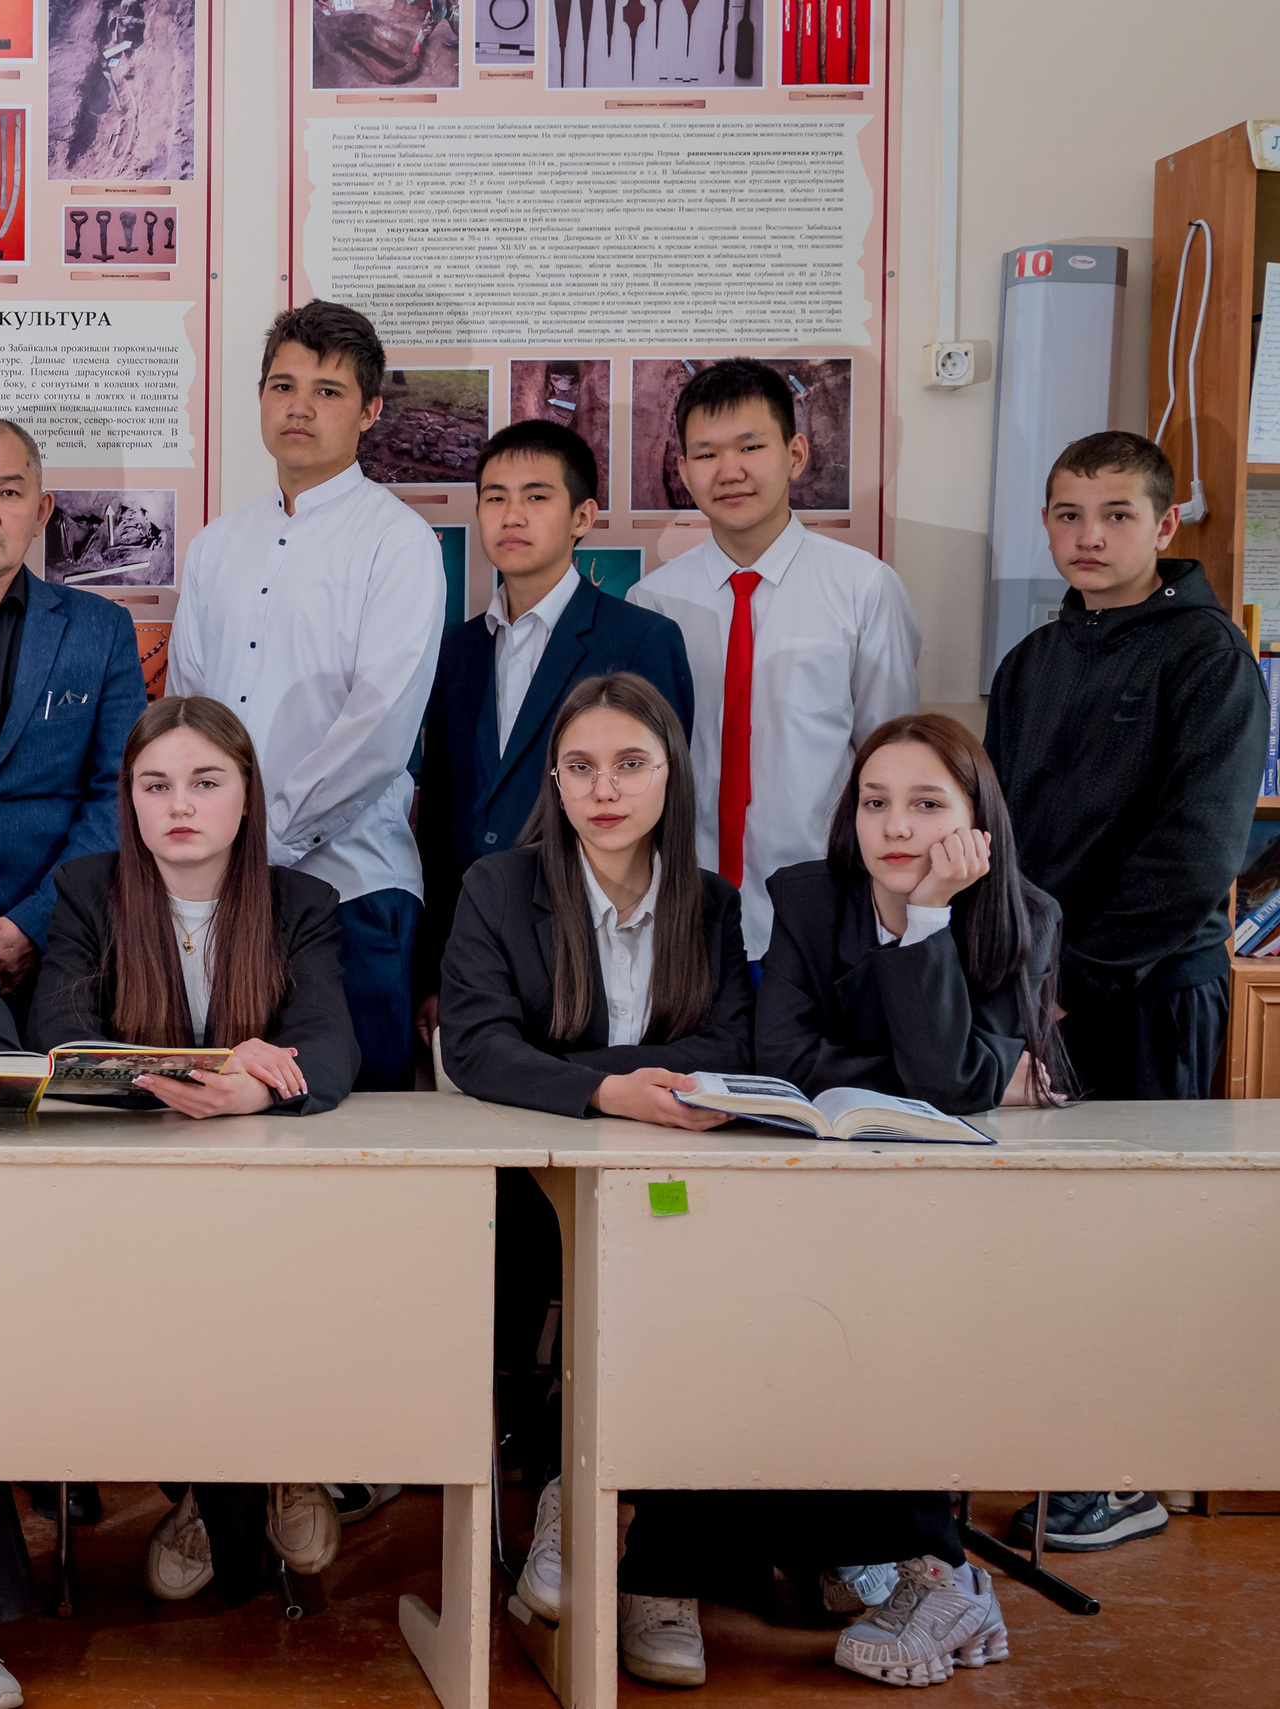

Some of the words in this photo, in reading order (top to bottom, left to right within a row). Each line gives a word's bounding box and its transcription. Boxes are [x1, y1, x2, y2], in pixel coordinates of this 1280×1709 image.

[1016, 250, 1053, 278] 10
[8, 343, 58, 352] Забайкалья
[61, 346, 110, 354] проживали
[114, 346, 179, 355] тюркоязычные
[30, 355, 65, 364] Данные
[116, 358, 179, 366] существовали
[30, 367, 68, 376] Племена
[75, 367, 130, 378] дарасунской
[136, 370, 179, 378] культуры
[3, 379, 26, 390] боку,
[40, 381, 89, 390] согнутыми
[144, 382, 179, 390] ногами,
[43, 393, 80, 402] согнуты
[140, 394, 179, 402] подняты
[17, 405, 57, 414] умерших
[60, 405, 132, 414] подкладывались
[49, 417, 81, 426] восток,
[83, 417, 145, 426] северо-восток
[33, 427, 84, 438] погребений
[107, 430, 165, 438] встречаются.
[56, 439, 86, 450] вещей,
[96, 441, 152, 450] характерных
[163, 442, 178, 450] для
[1254, 892, 1280, 923] ИСТОРИ
[1092, 1509, 1105, 1523] AIR
